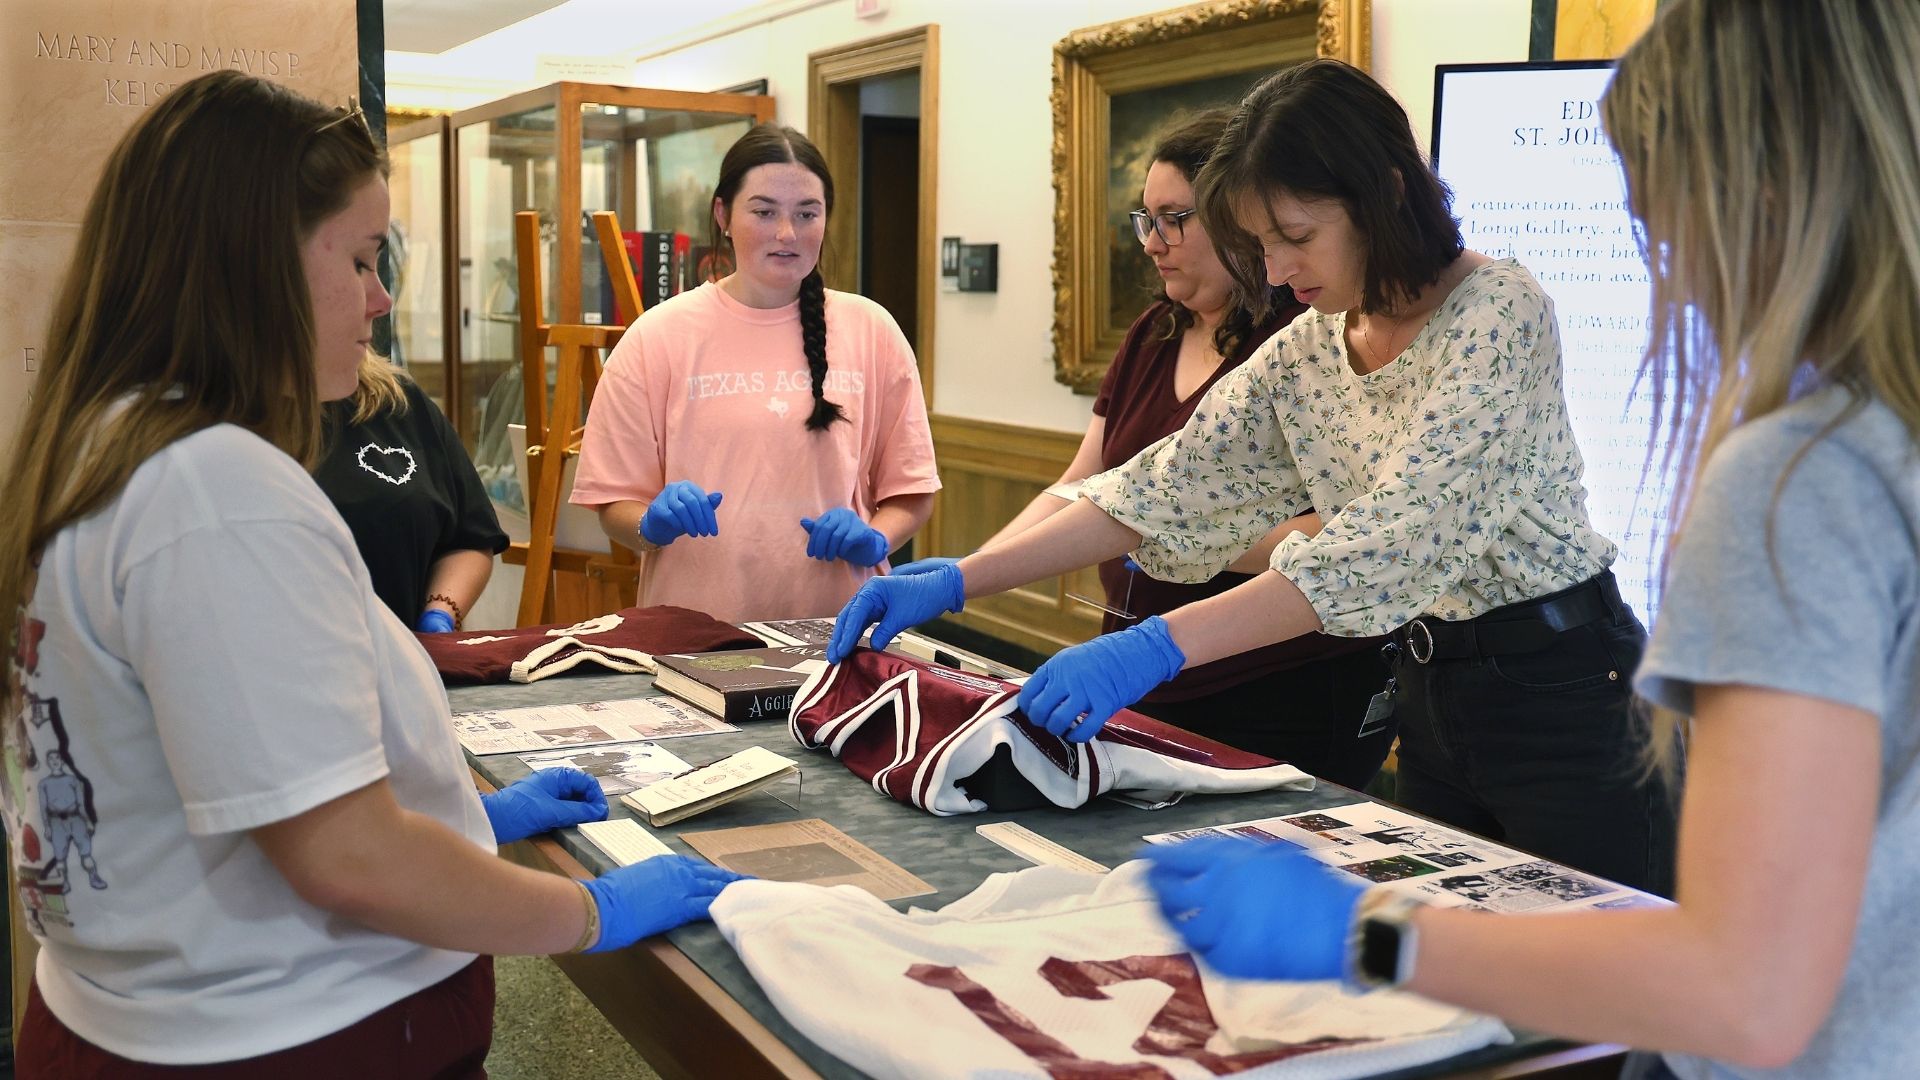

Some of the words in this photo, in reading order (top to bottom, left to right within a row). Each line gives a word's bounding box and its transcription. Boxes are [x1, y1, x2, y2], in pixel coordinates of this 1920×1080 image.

[34, 31, 117, 63] MARY
[127, 40, 192, 69] AND
[200, 46, 280, 77] MAVIS
[287, 53, 303, 78] P.
[1561, 100, 1594, 120] ED
[1513, 126, 1548, 146] ST.
[1558, 126, 1607, 146] JOH
[1471, 219, 1520, 239] Long
[1611, 243, 1641, 259] bio
[1534, 266, 1601, 282] tation
[1609, 272, 1649, 283] awa
[686, 371, 766, 400] TEXAS
[774, 370, 865, 394] AGIES
